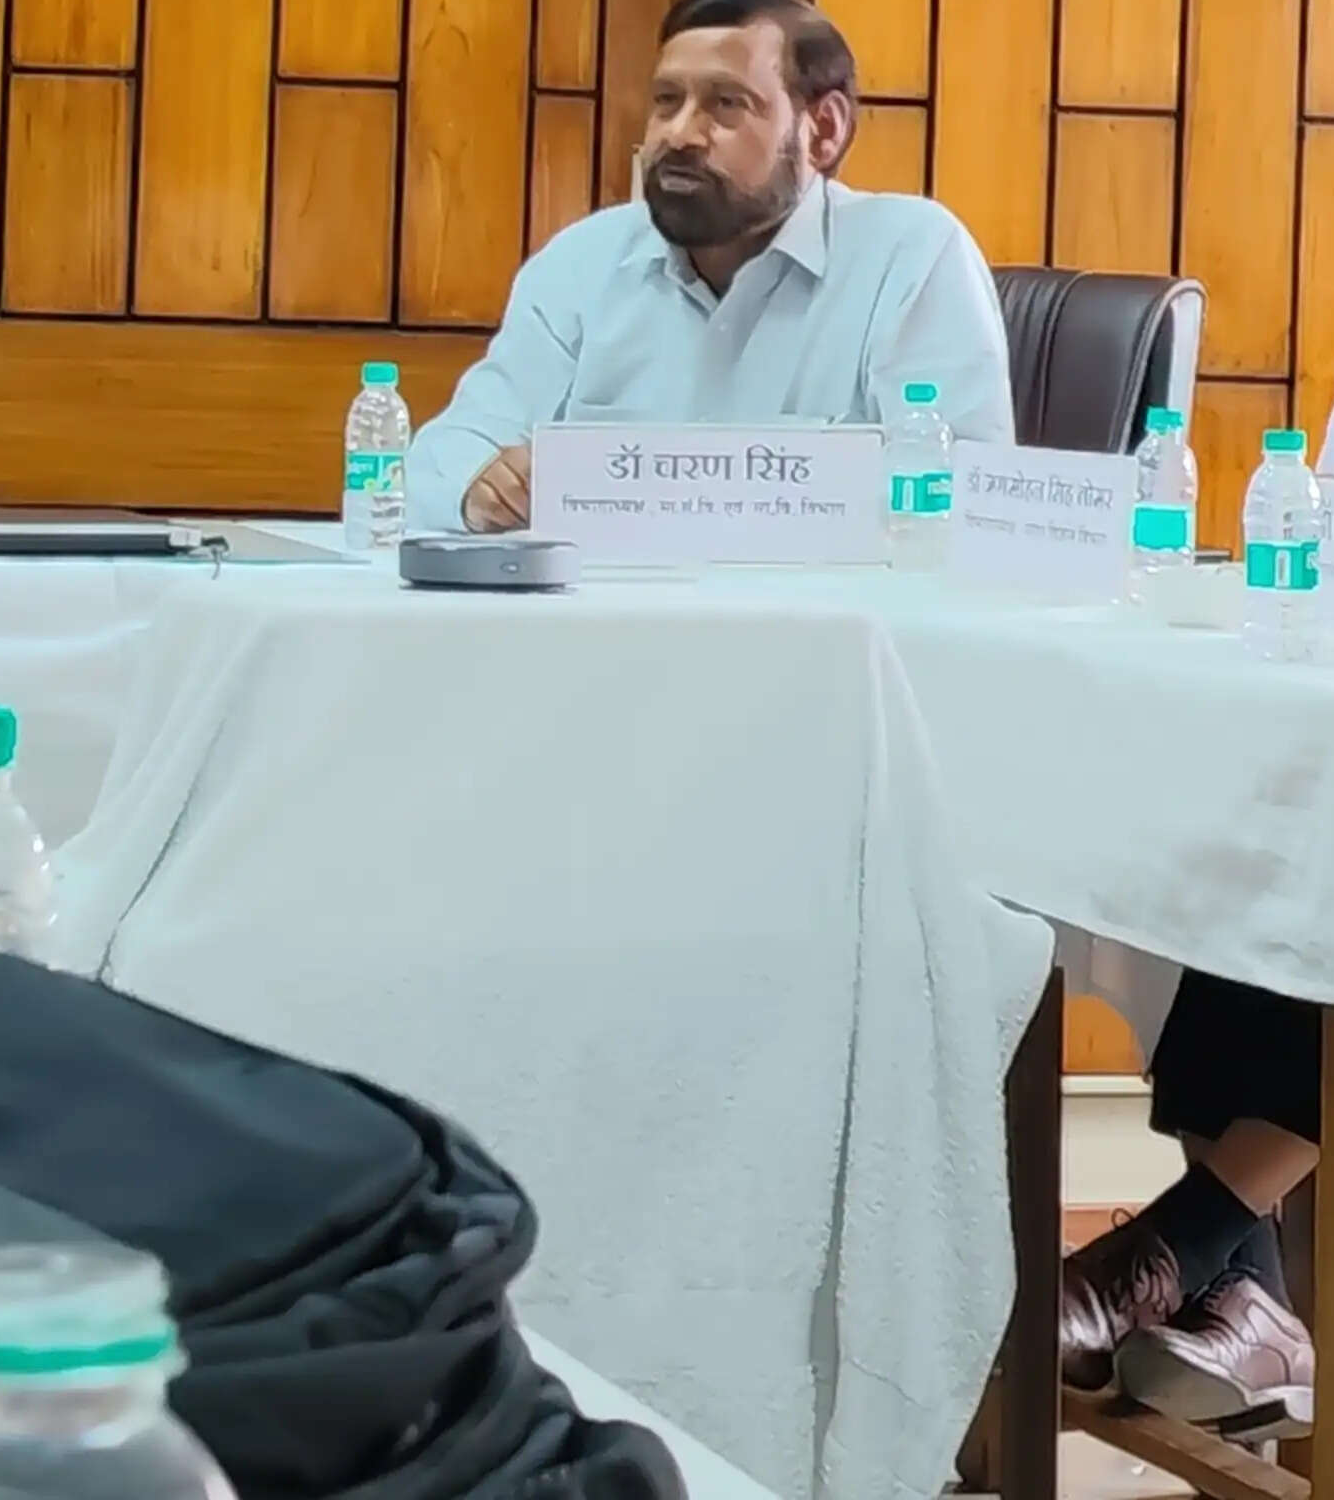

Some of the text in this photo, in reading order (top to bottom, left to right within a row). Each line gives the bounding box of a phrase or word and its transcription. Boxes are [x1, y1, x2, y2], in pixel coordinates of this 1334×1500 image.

[606, 444, 814, 485] डॉ चरण सिंह
